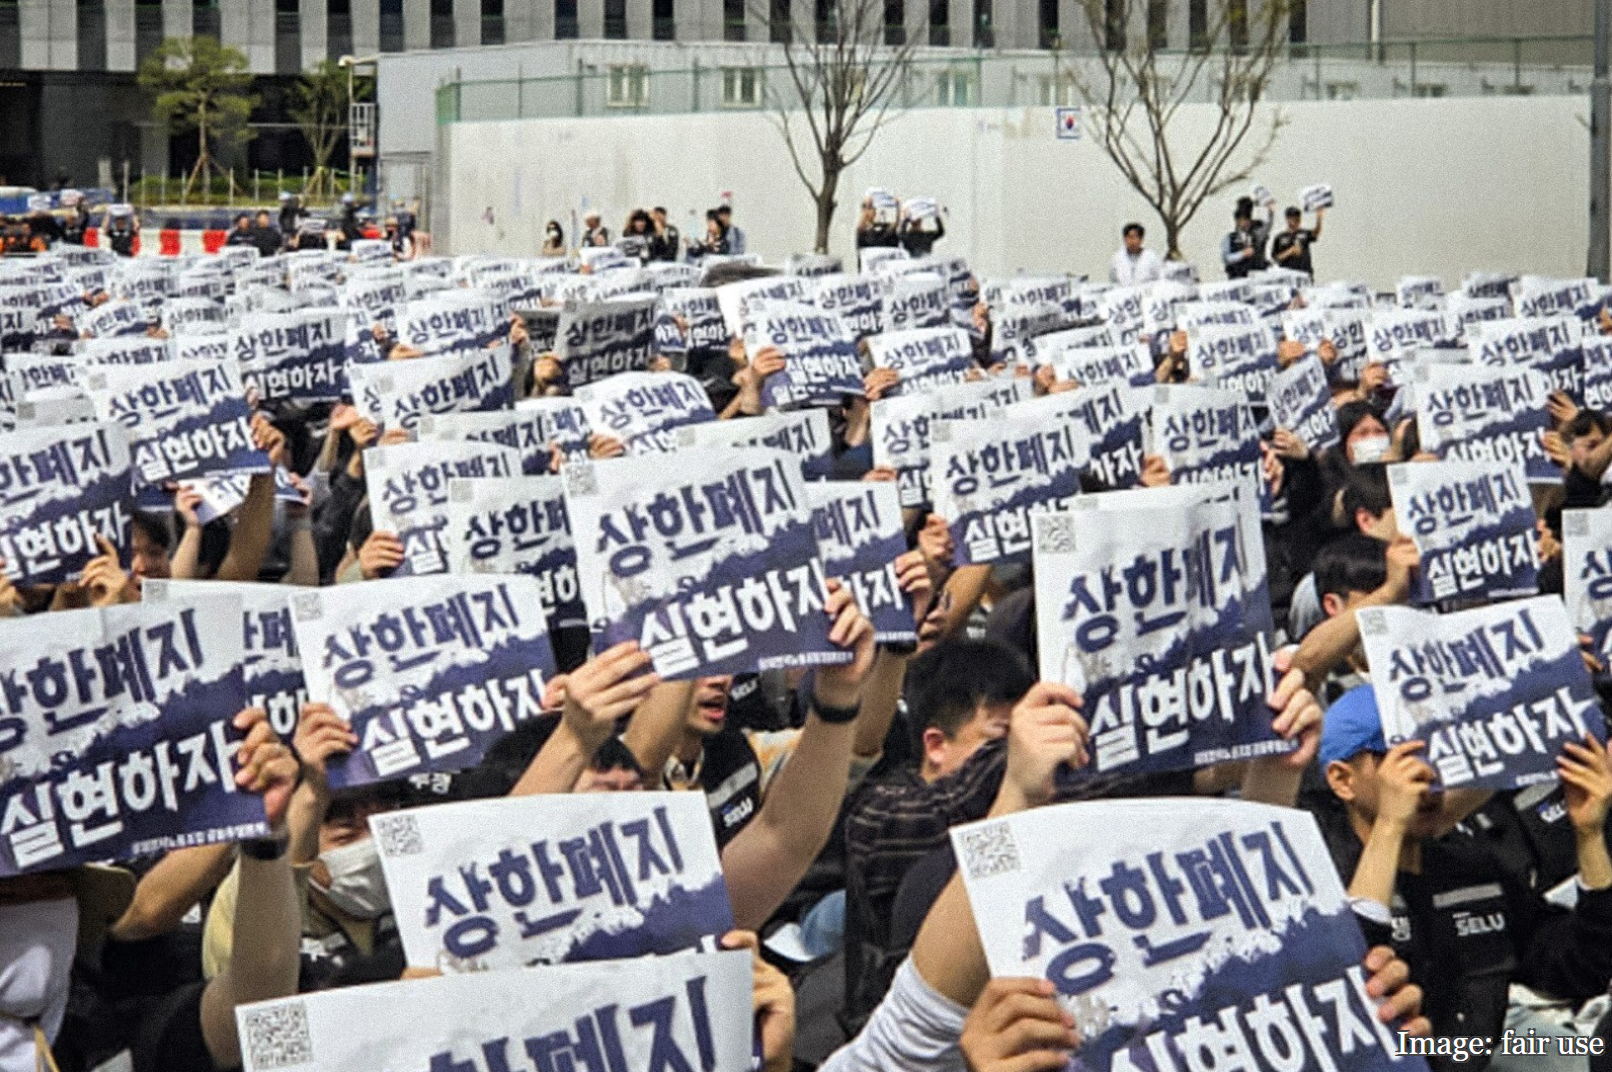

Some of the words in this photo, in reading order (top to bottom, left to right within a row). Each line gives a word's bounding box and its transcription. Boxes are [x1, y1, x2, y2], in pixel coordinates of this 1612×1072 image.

[234, 319, 331, 360] 상한폐지
[1332, 319, 1364, 351] 상한
[1481, 321, 1570, 366] 상한폐지
[109, 364, 231, 428] 상한폐지
[395, 354, 499, 429] 상한폐지
[601, 380, 704, 430] 상한폐지
[1164, 404, 1260, 453] 상한폐지
[1428, 373, 1534, 426] 상한폐지
[0, 429, 111, 506] 한폐지
[134, 416, 256, 482] 실현하자
[946, 425, 1075, 496] 상한폐지
[596, 459, 796, 579] 상한폐지
[1408, 469, 1521, 536] 상한폐지
[1062, 511, 1247, 654] 상한폐지
[1428, 529, 1543, 600] 실현하자
[323, 583, 519, 691] 상한폐지
[641, 557, 829, 679] 실현하자
[1390, 608, 1545, 702] 상한폐지
[362, 668, 547, 778] 실현하자
[1089, 631, 1273, 773] 실현하자
[1430, 686, 1597, 788] 실현하자
[0, 720, 245, 868] 실현하자
[426, 805, 685, 960] 상한폐지
[1021, 820, 1315, 997] 상한폐지
[1454, 913, 1505, 937] SELU
